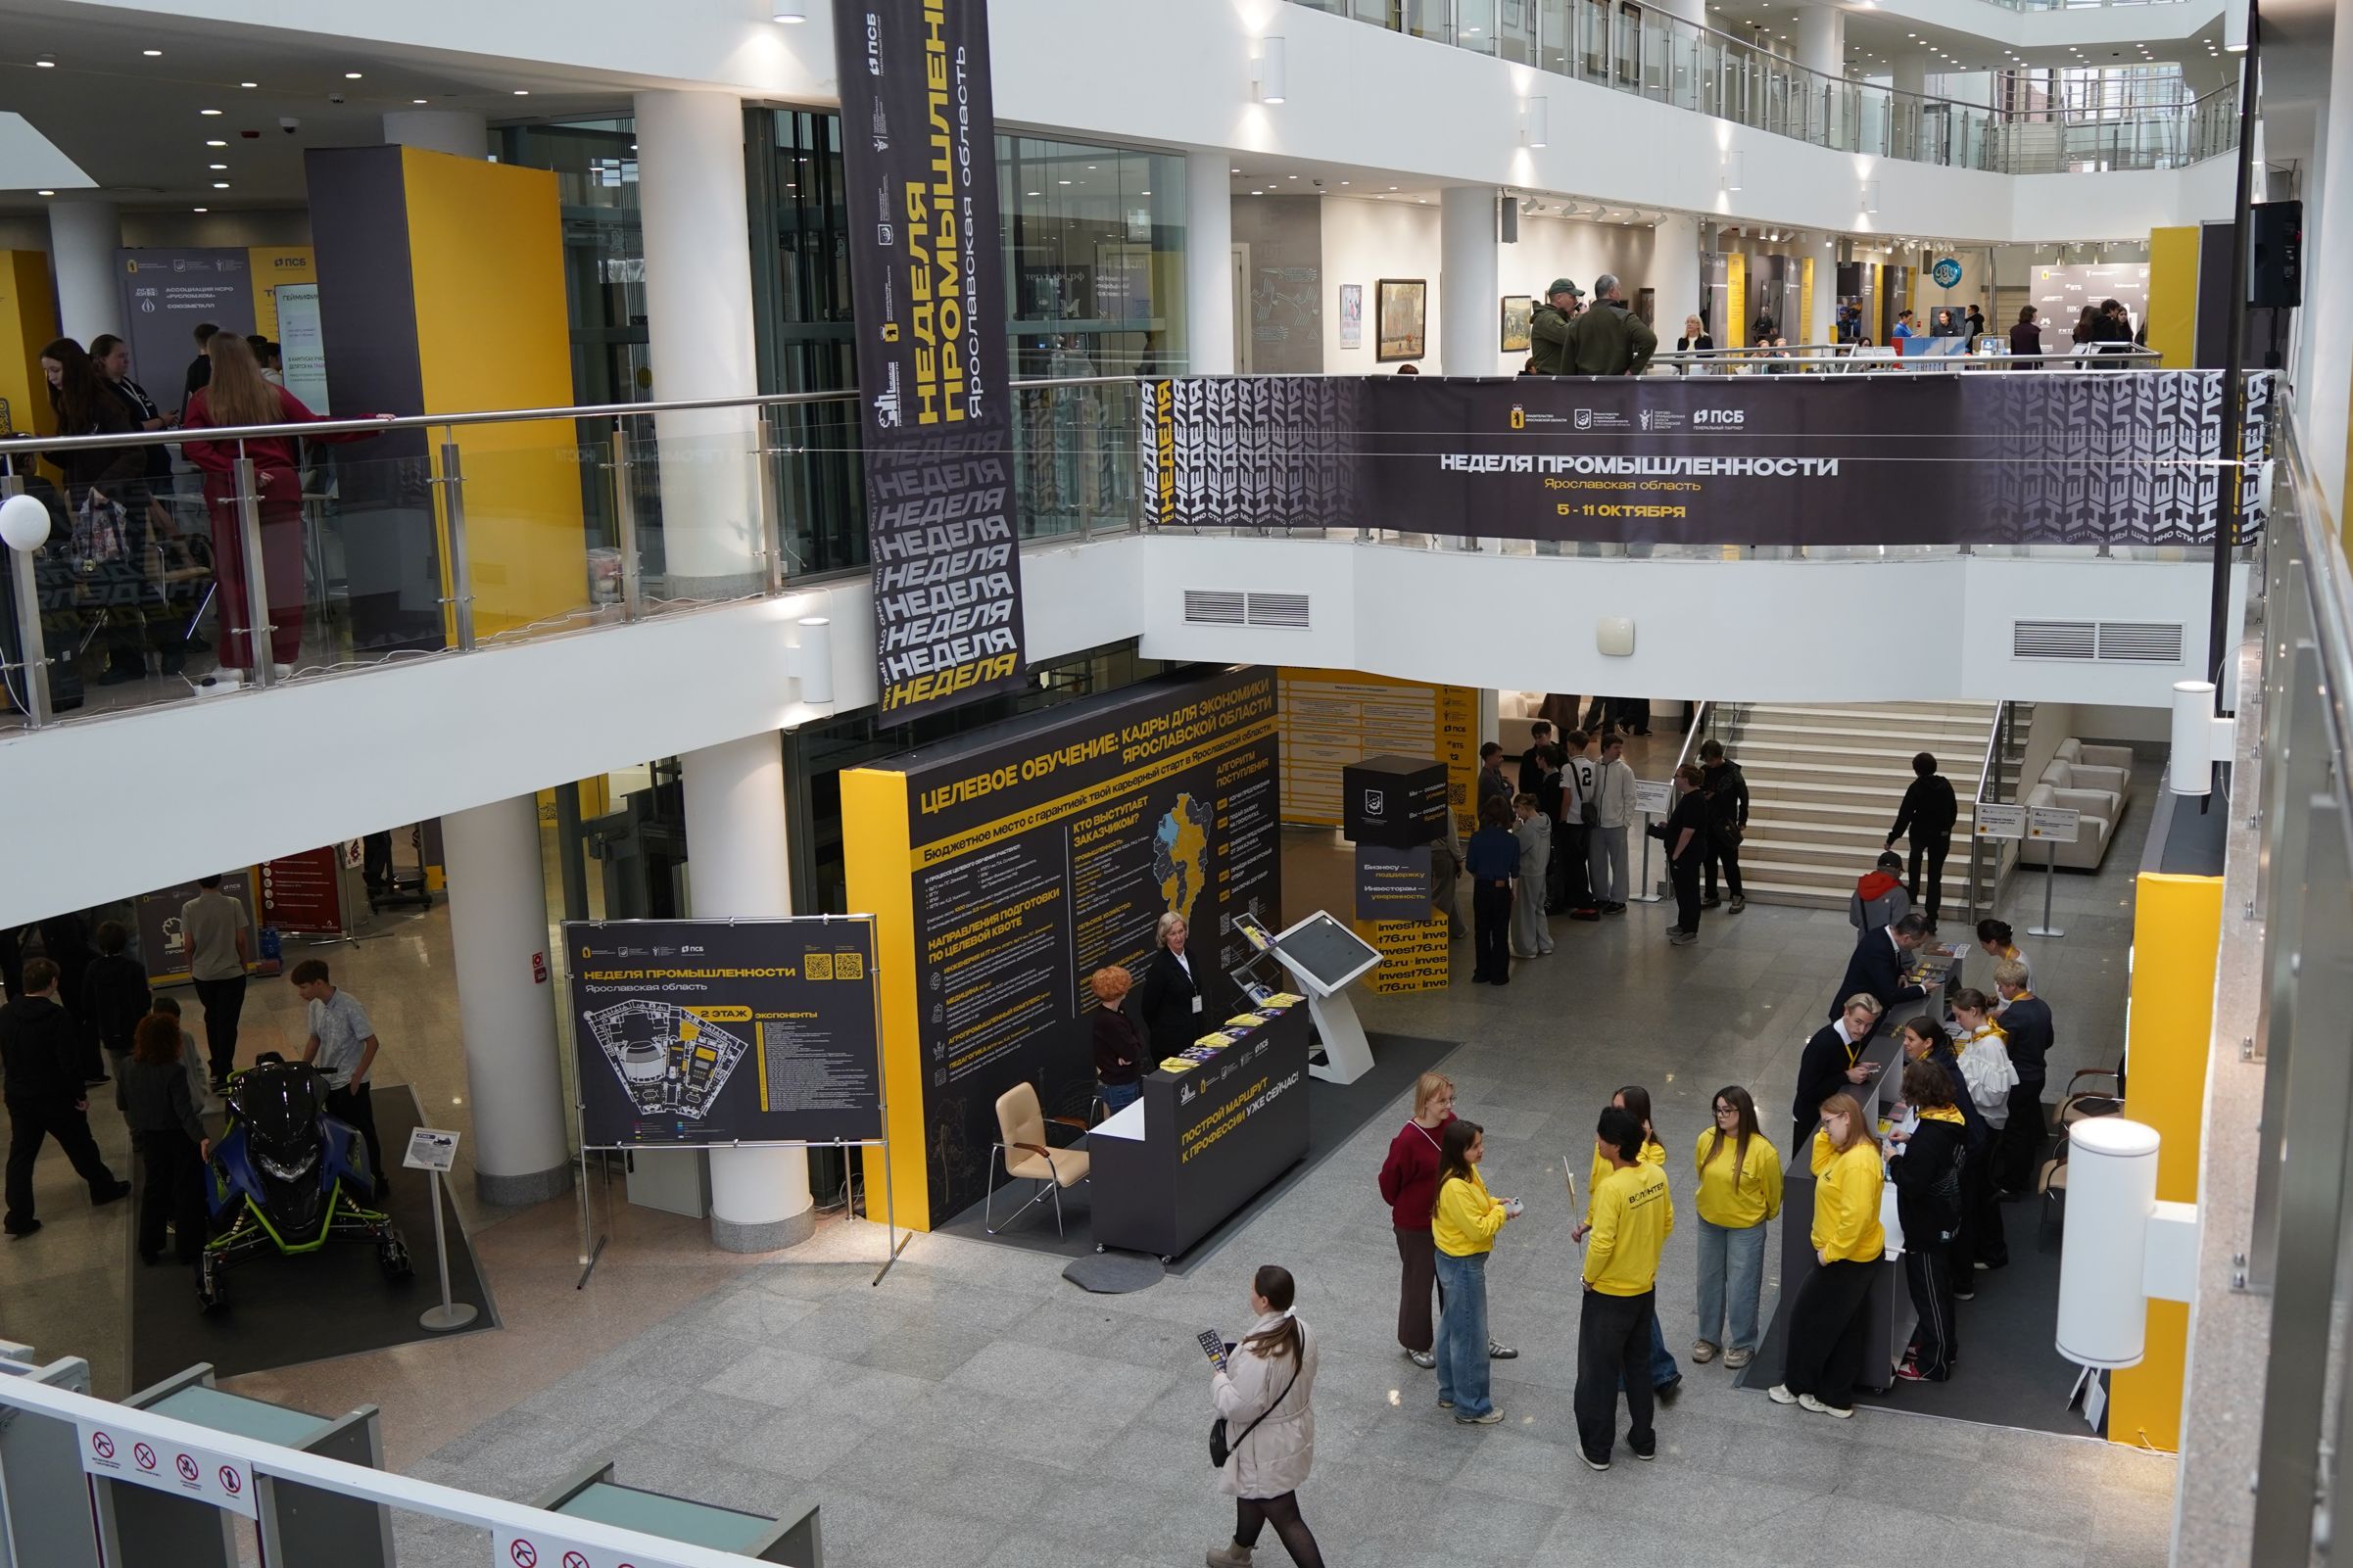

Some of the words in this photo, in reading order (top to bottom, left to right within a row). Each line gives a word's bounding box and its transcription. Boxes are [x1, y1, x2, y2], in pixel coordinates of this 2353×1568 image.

[867, 13, 878, 58] ПСБ
[956, 46, 972, 186] область
[924, 0, 965, 422] ПРОМЫШЛЕН
[285, 258, 307, 267] ПСБ
[906, 181, 938, 425] НЕДЕЛЯ
[964, 197, 984, 419] Ярославская
[1710, 409, 1744, 423] ПСБ
[1142, 381, 1159, 514] НЕДЕЛЯ
[1158, 380, 1175, 514] НЕДЕЛЯ
[1174, 379, 1189, 514] НЕДЕЛЯ
[1189, 379, 1206, 514] НЕДЕЛЯ
[1206, 379, 1223, 514] НЕДЕЛЯ
[1222, 379, 1238, 514] НЕДЕЛЯ
[1238, 379, 1254, 514] НЕДЕЛЯ
[1254, 378, 1272, 514] НЕДЕЛЯ
[1272, 378, 1287, 514] НЕДЕЛЯ
[1287, 378, 1305, 514] НЕДЕЛЯ
[1304, 378, 1320, 514] НЕДЕЛЯ
[1440, 453, 1533, 474] НЕДЕЛЯ
[1538, 455, 1839, 476] ПРОМЫШЛЕННОСТИ
[2089, 374, 2108, 532] НЕДЕЛЯ
[2108, 374, 2133, 532] НЕДЕЛЯ
[2132, 372, 2154, 532] НЕДЕЛЯ
[2153, 372, 2179, 533] НЕДЕЛЯ
[2176, 372, 2199, 533] НЕДЕЛЯ
[2197, 371, 2224, 533] НЕДЕЛЯ
[875, 458, 1006, 499] НЕДЕЛЯ
[1544, 478, 1636, 491] Ярославская
[1640, 479, 1701, 492] область
[878, 487, 1007, 531] НЕДЕЛЯ
[1145, 513, 1159, 525] ПРО
[1161, 513, 1175, 525] МЫ
[1176, 513, 1188, 525] ШЛЕ
[1191, 513, 1207, 525] ННО
[1208, 513, 1222, 525] СТИ
[1225, 513, 1238, 525] ПРО
[1240, 513, 1254, 525] МЫ
[1256, 513, 1272, 525] ШЛЕ
[1558, 503, 1568, 515] 5
[1583, 504, 1595, 515] 11
[1598, 504, 1686, 518] ОКТЯБРЯ
[878, 514, 1012, 561] НЕДЕЛЯ
[2110, 531, 2128, 543] МЫ
[2132, 531, 2149, 543] ШЛЕ
[2153, 531, 2173, 543] ННО
[2176, 531, 2194, 543] СТИ
[882, 543, 1012, 592] НЕДЕЛЯ
[883, 571, 1015, 621] НЕДЕЛЯ
[886, 597, 1015, 651] НЕДЕЛЯ
[880, 662, 889, 686] ПРО
[887, 627, 1018, 681] НЕДЕЛЯ
[882, 688, 891, 711] МЫ
[890, 652, 1019, 710] НЕДЕЛЯ
[1123, 714, 1170, 744] КАДРЫ
[1172, 705, 1197, 727] ДЛЯ
[1199, 678, 1270, 716] ЭКОНОМИКИ
[1123, 715, 1217, 764] ЯРОСЛАВСКОЙ
[1219, 695, 1272, 728] ОБЛАСТИ
[921, 764, 1019, 815] ЦЕЛЕВОЕ
[1021, 733, 1119, 781] ОБУЧЕНИЕ:
[924, 831, 991, 862] Бюджетное
[993, 819, 1026, 836] место
[1029, 815, 1034, 825] с
[1035, 795, 1087, 821] гарантией:
[1089, 787, 1111, 801] твой
[1113, 768, 1160, 792] карьерный
[1161, 758, 1183, 775] старт
[1192, 736, 1241, 762] Ярославской
[1242, 724, 1272, 739] области
[1217, 758, 1270, 788] ПОСТУПЛЕНИЯ
[1582, 767, 1591, 785] 2
[1074, 819, 1093, 834] КТО
[1093, 795, 1149, 827] ВЫСТУПАЕТ
[1074, 813, 1140, 848] ЗАКАЗЧИКОМ?
[928, 913, 999, 950] НАПРАВЛЕНИЯ
[1000, 887, 1060, 921] ПОДГОТОВКИ
[929, 951, 943, 964] ПО
[945, 928, 991, 958] ЦЕЛЕВОЙ
[991, 917, 1023, 938] КВОТЕ
[1376, 934, 1415, 944] t76.ru
[1378, 920, 1448, 931] invest76.ru
[944, 954, 980, 974] ИНЖЕНЕРИЯ
[1378, 944, 1448, 956] invest76.ru
[584, 970, 643, 979] НЕДЕЛЯ
[647, 968, 795, 978] ПРОМЫШЛЕННОСТИ
[946, 986, 980, 1006] МЕДИЦИНА
[1376, 983, 1415, 992] t76.ru
[1378, 968, 1448, 980] invest76.ru
[948, 1047, 987, 1069] ПЕДАГОГИКА
[1260, 1038, 1269, 1051] ПСБ
[1181, 1105, 1225, 1146] ПОСТРОЙ
[1225, 1077, 1269, 1117] МАРШРУТ
[1181, 1152, 1189, 1164] К
[1189, 1111, 1246, 1156] ПРОФЕССИИ
[1246, 1095, 1266, 1117] УЖЕ
[1266, 1071, 1299, 1103] СЕЙЧАС!
